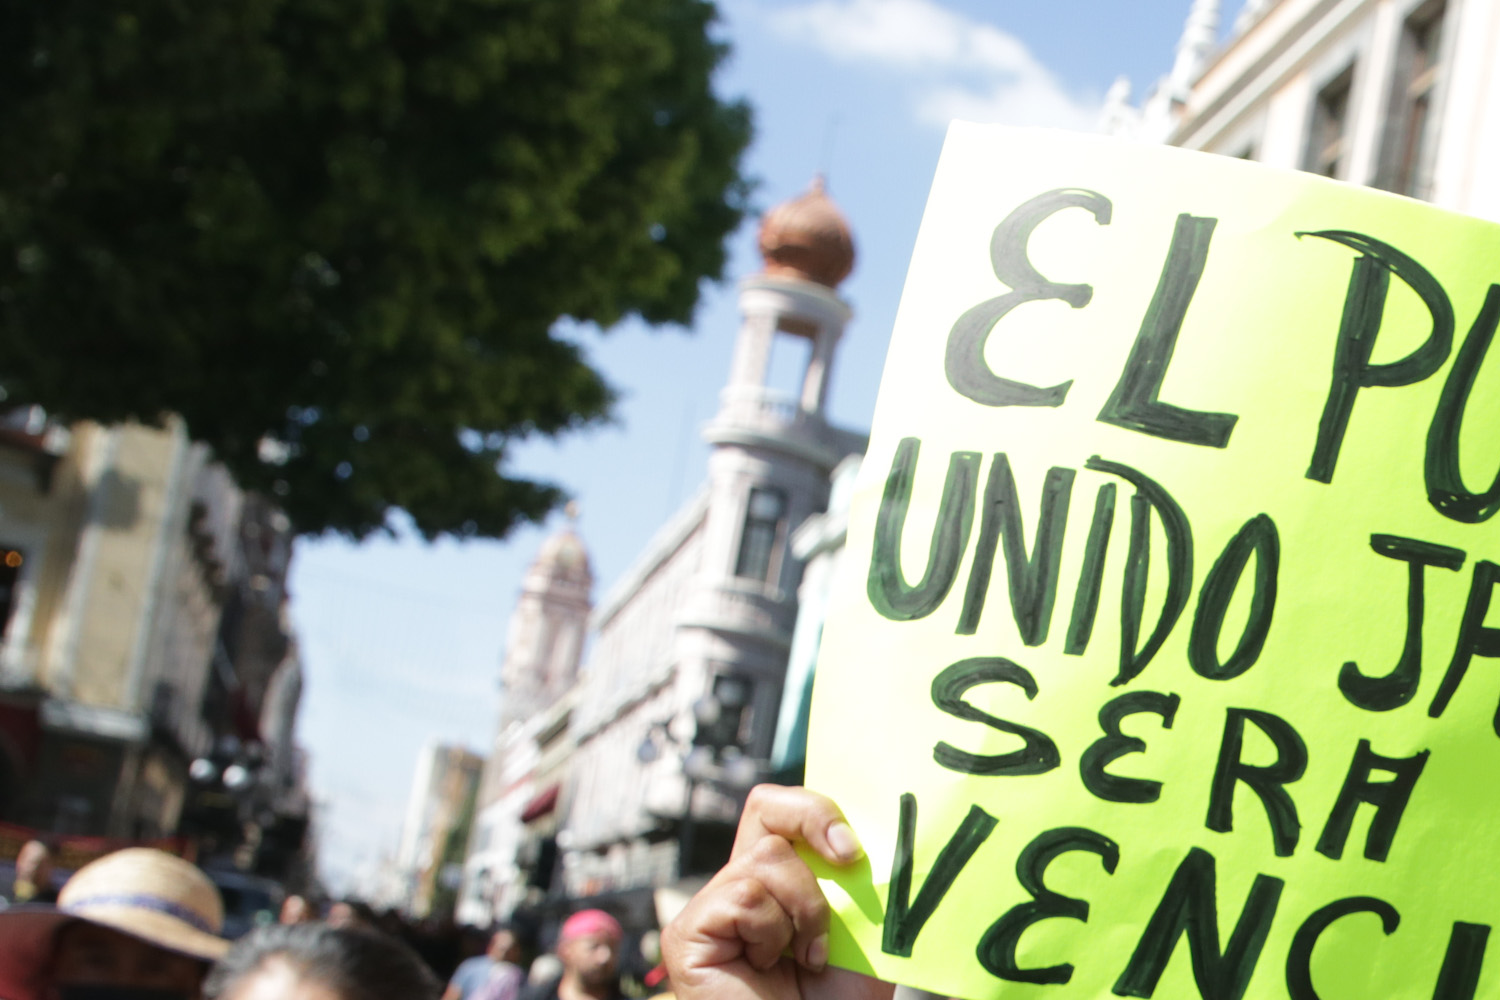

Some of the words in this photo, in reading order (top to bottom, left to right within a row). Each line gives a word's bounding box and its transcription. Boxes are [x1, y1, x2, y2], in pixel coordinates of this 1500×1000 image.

[944, 187, 1240, 449] EL
[866, 436, 1281, 688] UNIDO
[930, 657, 1432, 864] SERA
